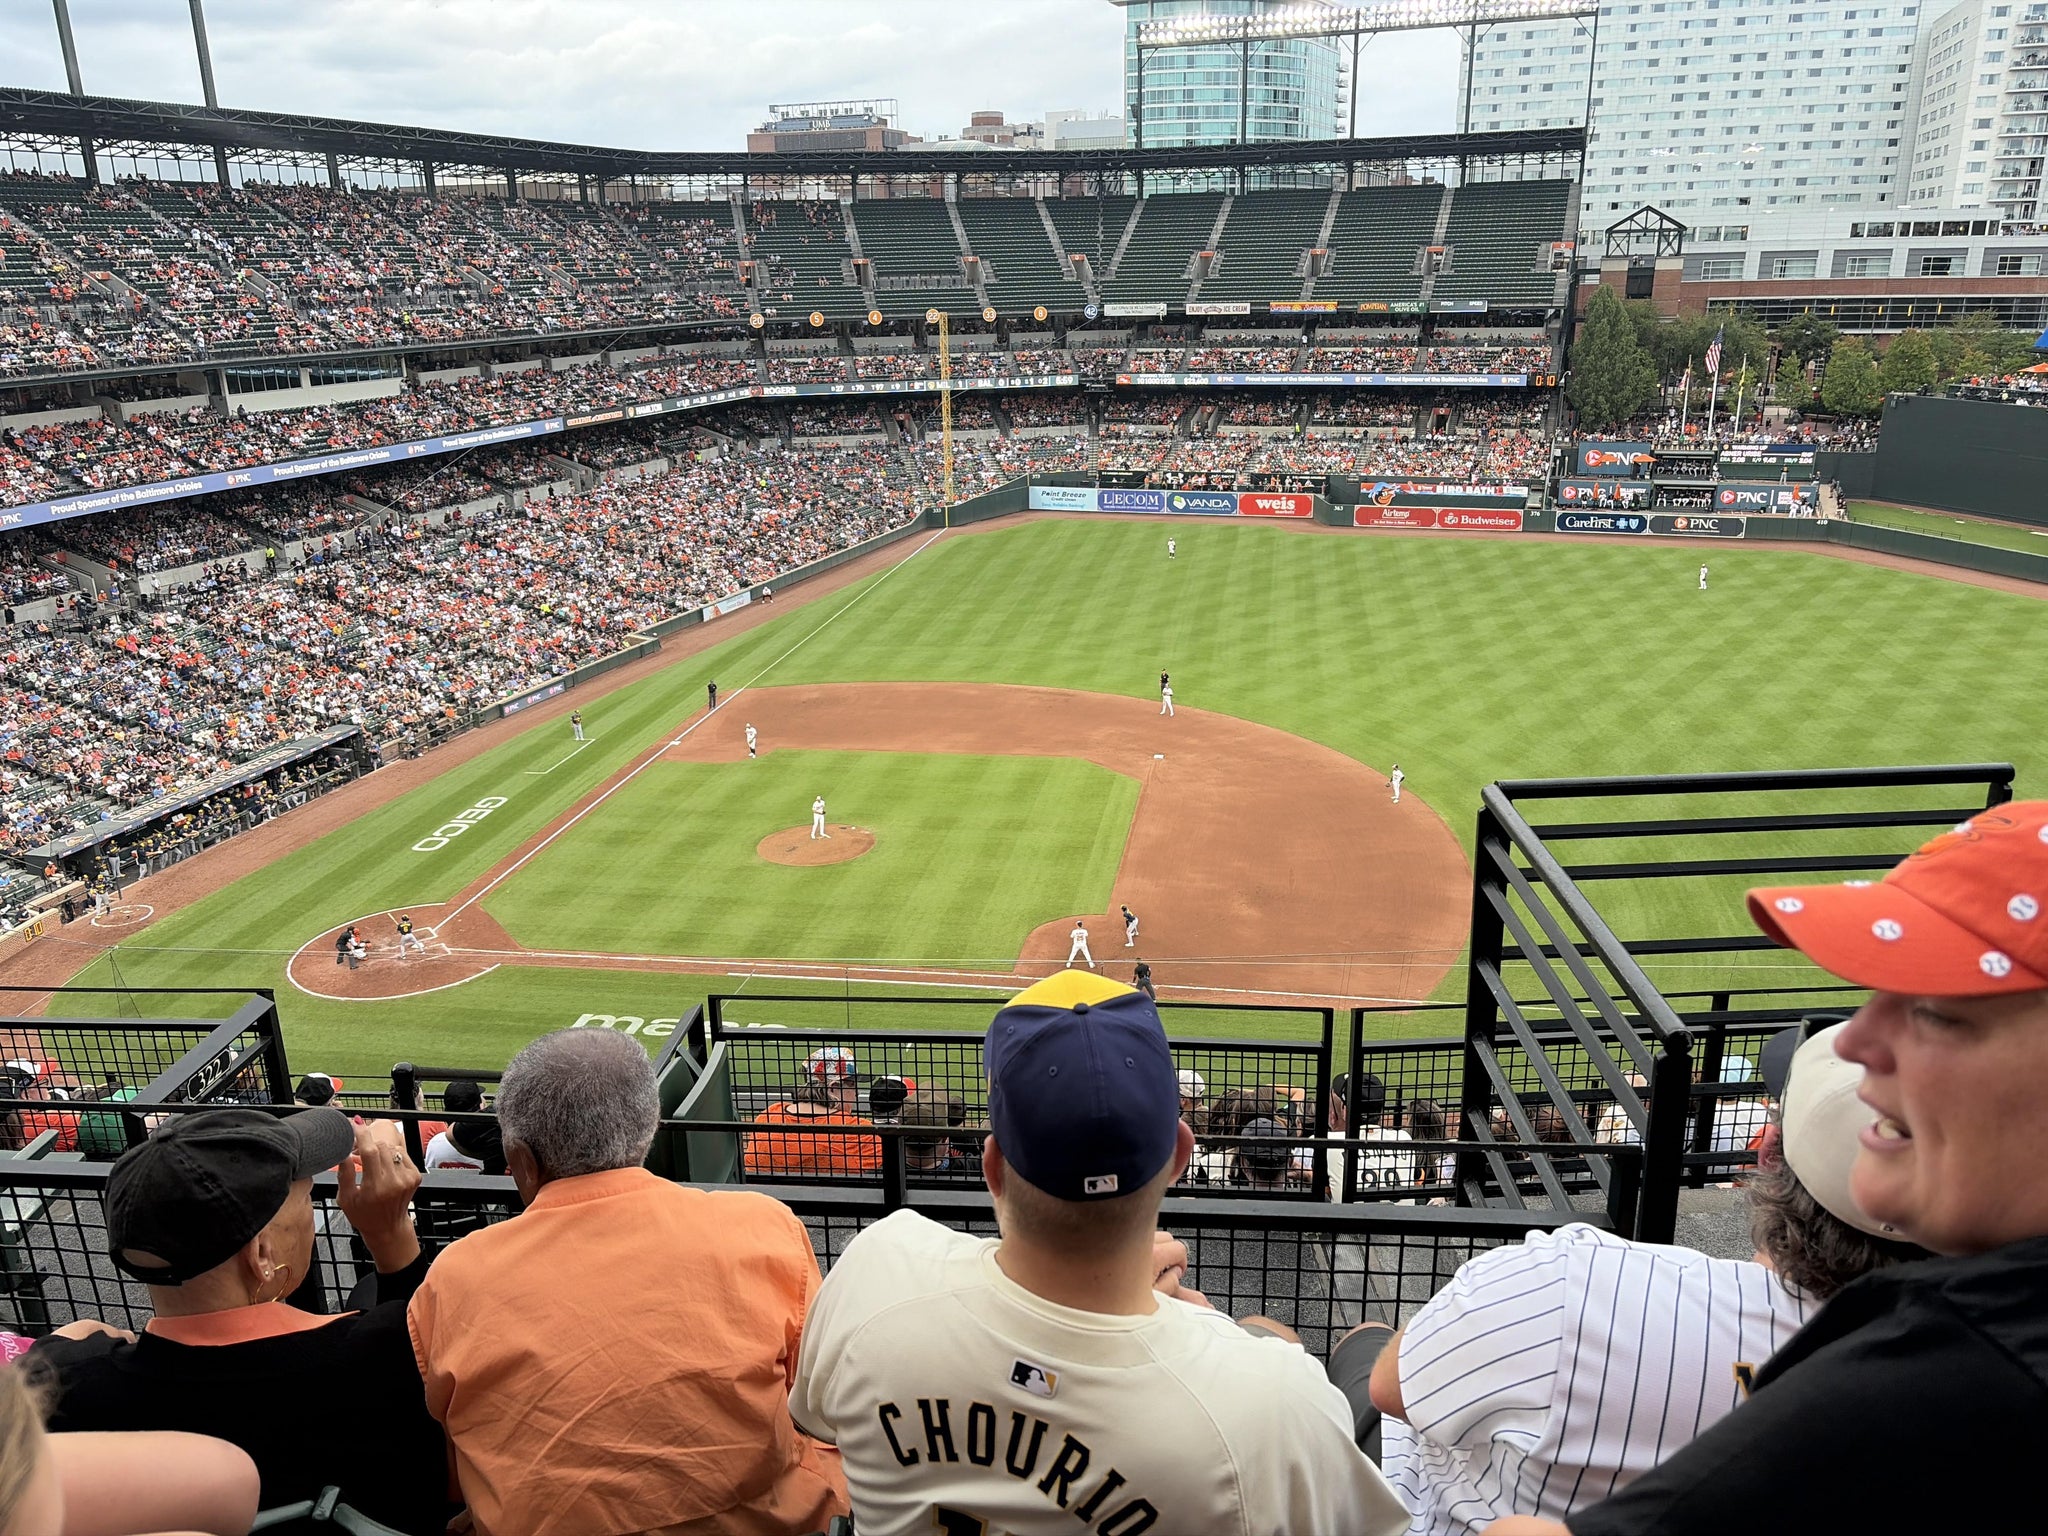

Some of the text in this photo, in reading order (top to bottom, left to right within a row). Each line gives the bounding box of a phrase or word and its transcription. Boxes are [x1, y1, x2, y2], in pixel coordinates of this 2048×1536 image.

[812, 119, 830, 128] UMB
[936, 381, 951, 389] MIL
[978, 380, 994, 388] BAL
[1536, 375, 1556, 386] 0:10
[764, 386, 797, 395] ROGERS
[273, 450, 390, 477] Proud Sponsor of the Baltimore Orioles
[235, 473, 251, 482] PNC
[1436, 484, 1495, 495] BIRD BATH
[51, 480, 203, 515] Proud Sponsor of the Baltimore Orioles
[1103, 493, 1160, 506] LECOM
[1186, 498, 1232, 508] VANDA
[1255, 496, 1296, 510] weis
[1736, 491, 1768, 504] PNC
[3, 512, 22, 524] PNC
[1565, 516, 1615, 529] CareFirst
[1690, 518, 1719, 530] PNC
[411, 796, 509, 852] GEICO
[198, 1058, 223, 1092] 322
[878, 1398, 1160, 1536] CHOURIO
